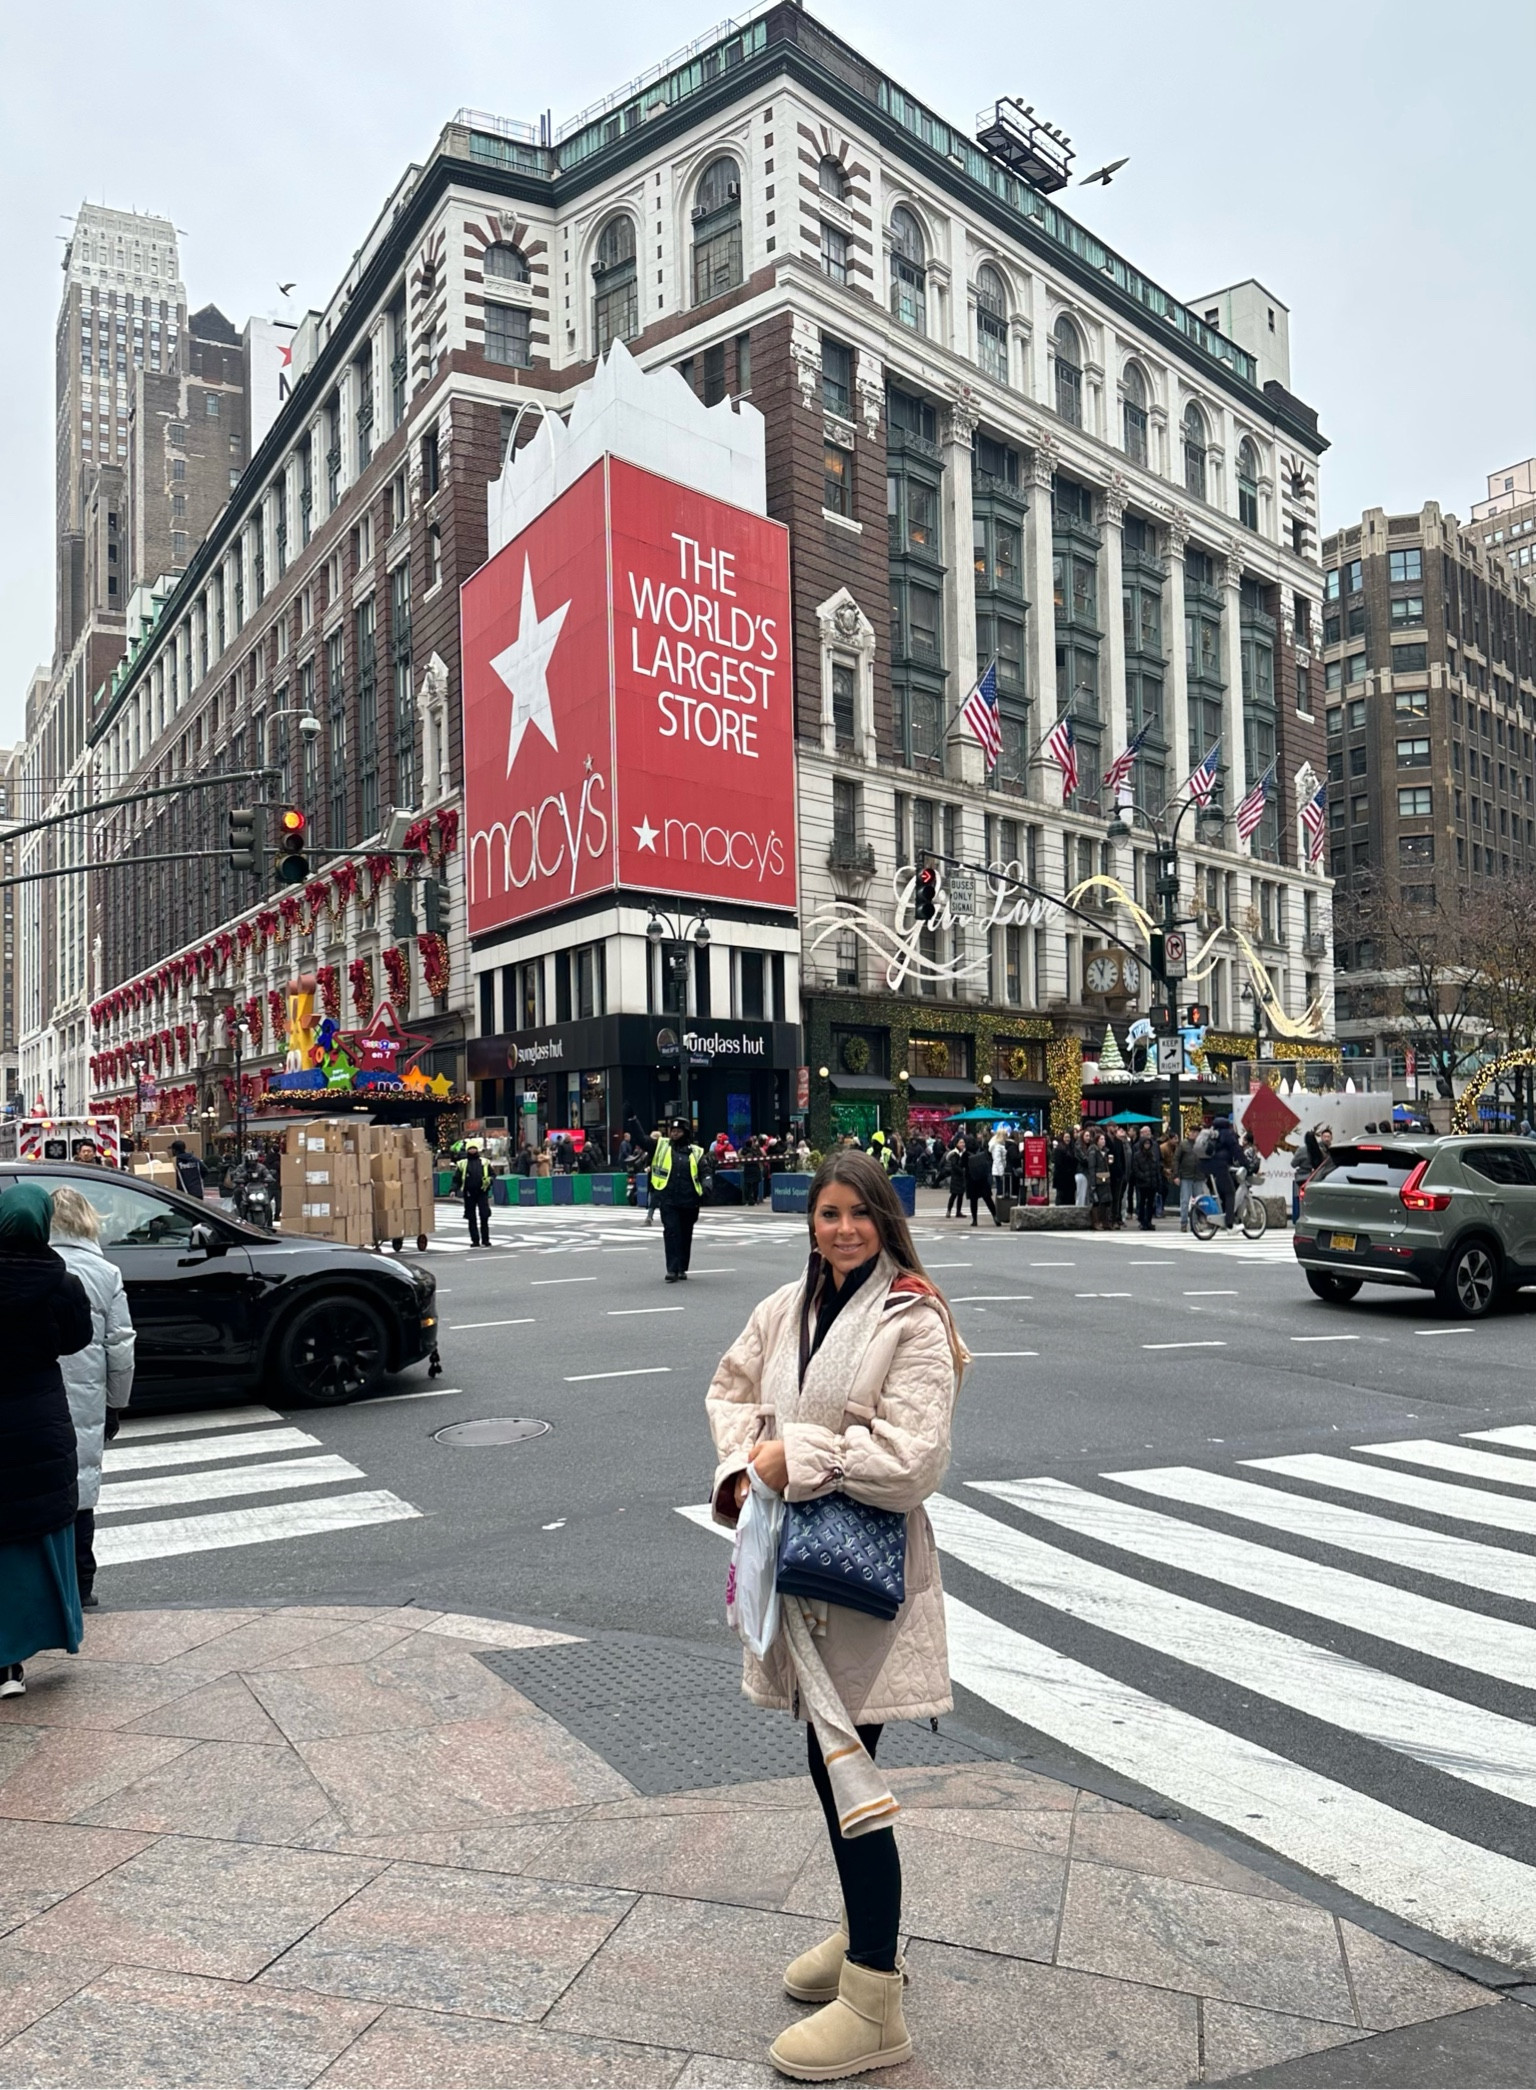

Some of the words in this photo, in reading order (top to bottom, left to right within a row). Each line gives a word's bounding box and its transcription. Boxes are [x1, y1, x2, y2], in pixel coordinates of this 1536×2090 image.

[671, 532, 738, 598] THE
[628, 571, 778, 661] WORLD'S
[631, 627, 775, 709] LARGEST
[658, 691, 759, 759] STORE
[470, 754, 608, 905] macy's
[664, 817, 785, 882] macy's
[951, 880, 974, 890] BUSES
[953, 891, 973, 901] ONLY
[979, 860, 1063, 934] Love
[951, 902, 974, 913] SIGNAL
[384, 1051, 391, 1059] 7
[518, 1041, 549, 1066] sunglass
[549, 1039, 564, 1059] hut
[742, 1033, 765, 1056] hut
[1161, 1039, 1179, 1048] KEEP
[1161, 1062, 1181, 1070] RIGHT
[774, 1187, 791, 1196] Herald
[792, 1187, 809, 1197] Squar
